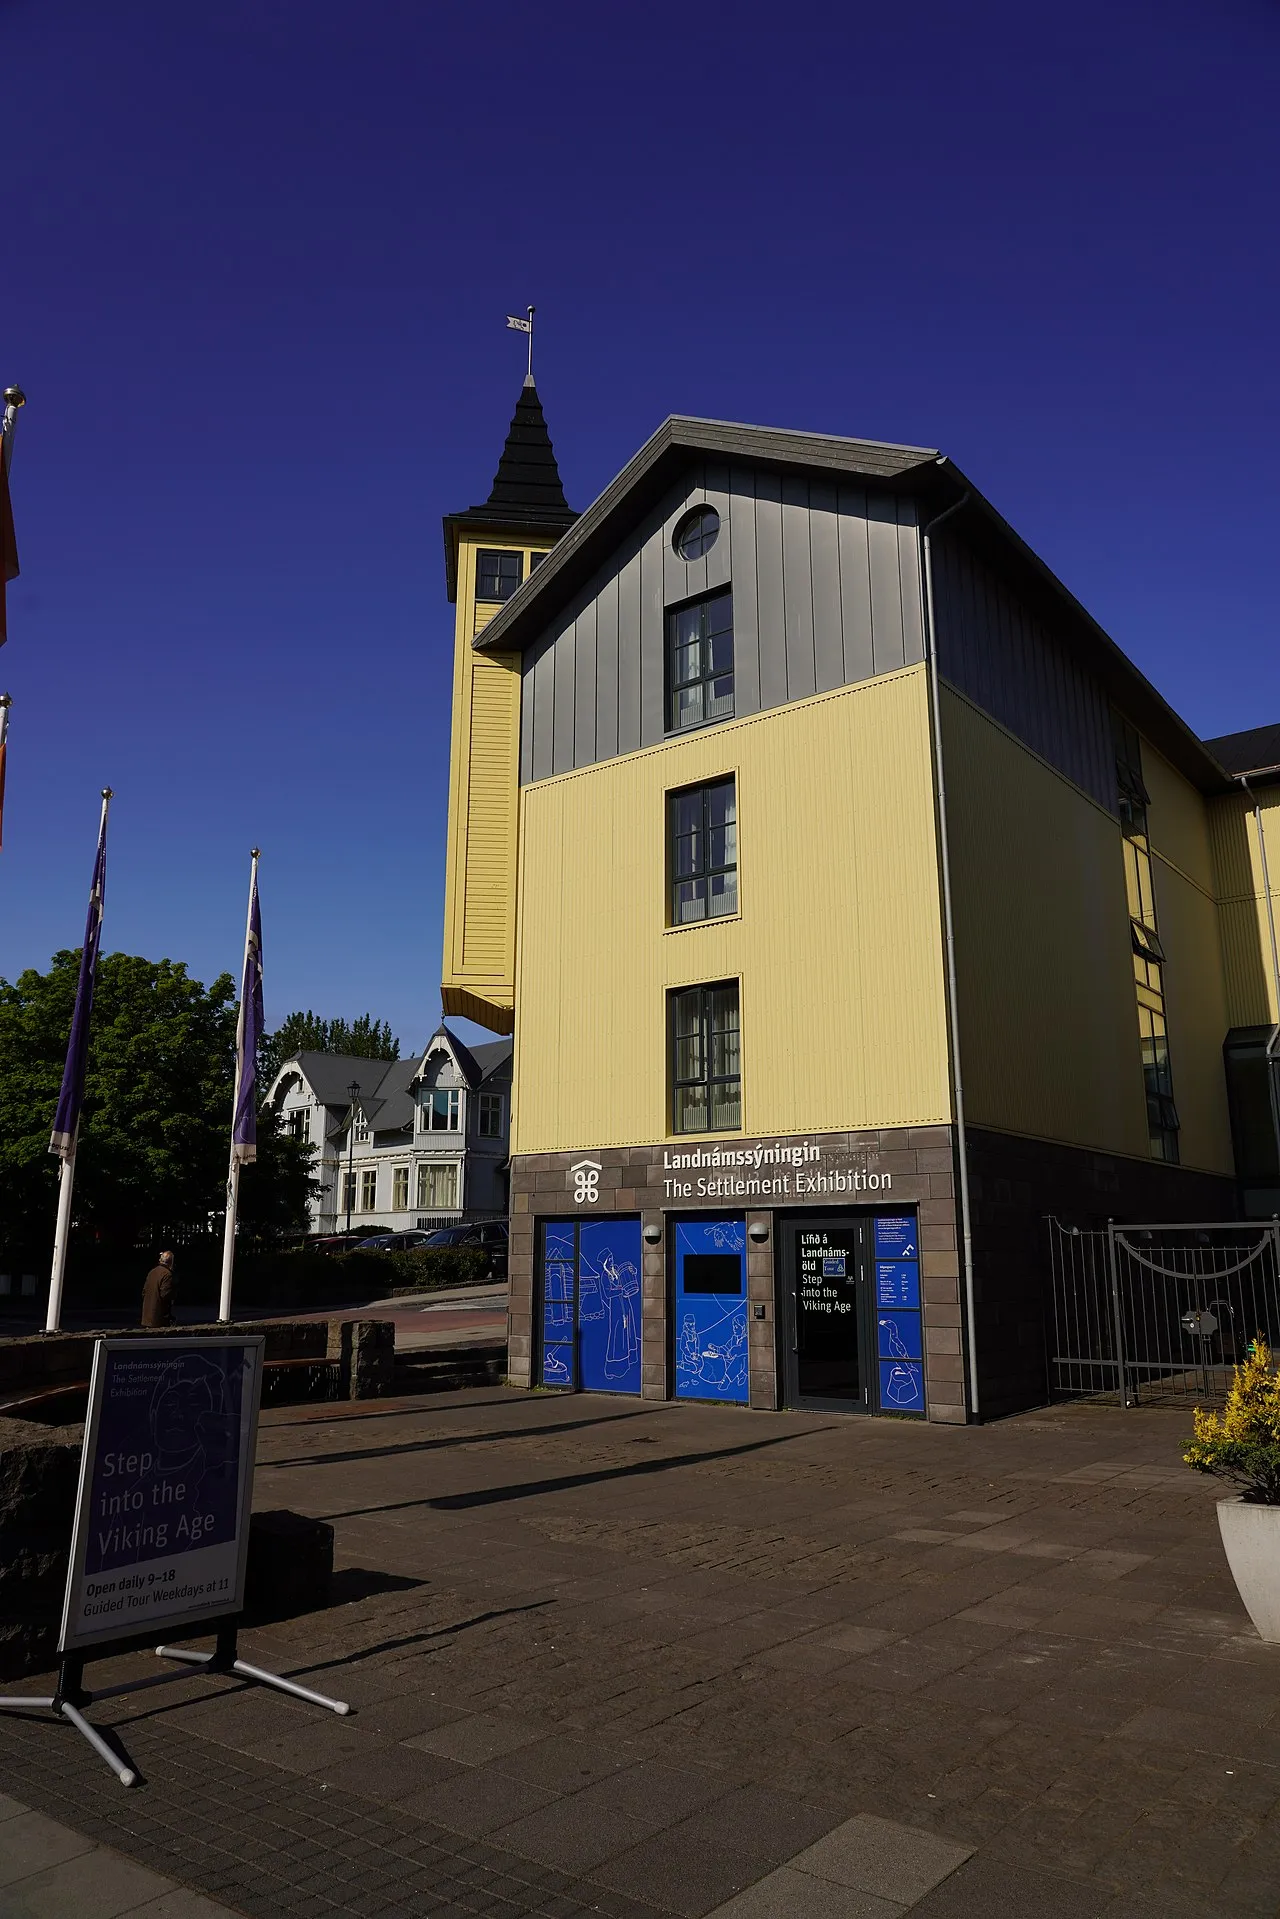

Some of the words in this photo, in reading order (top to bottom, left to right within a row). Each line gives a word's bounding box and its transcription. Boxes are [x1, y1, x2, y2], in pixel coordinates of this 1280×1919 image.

[664, 1141, 820, 1170] Landnámssýningin
[664, 1178, 692, 1198] The
[697, 1174, 791, 1197] Settlement
[796, 1169, 892, 1194] Exhibition
[801, 1234, 821, 1245] Lífið
[822, 1233, 828, 1244] á
[801, 1246, 850, 1258] Landnáms-
[801, 1260, 816, 1271] öld
[802, 1274, 823, 1286] Step
[802, 1287, 821, 1298] into
[823, 1287, 838, 1298] the
[802, 1300, 832, 1313] Viking
[833, 1301, 851, 1314] Age
[113, 1359, 185, 1371] Landnámssýningin
[112, 1374, 126, 1383] The
[128, 1374, 165, 1383] Settlement
[110, 1388, 148, 1398] Exhibition
[102, 1452, 152, 1477] Step
[100, 1490, 144, 1517] into
[152, 1480, 186, 1506] the
[98, 1522, 169, 1556] Viking
[176, 1513, 215, 1541] Age
[86, 1583, 116, 1598] Open
[119, 1574, 145, 1590] daily
[84, 1597, 124, 1617] Guided
[127, 1594, 150, 1608] Tour
[153, 1585, 204, 1603] Weekdays
[206, 1582, 216, 1593] at
[219, 1578, 229, 1589] 11
